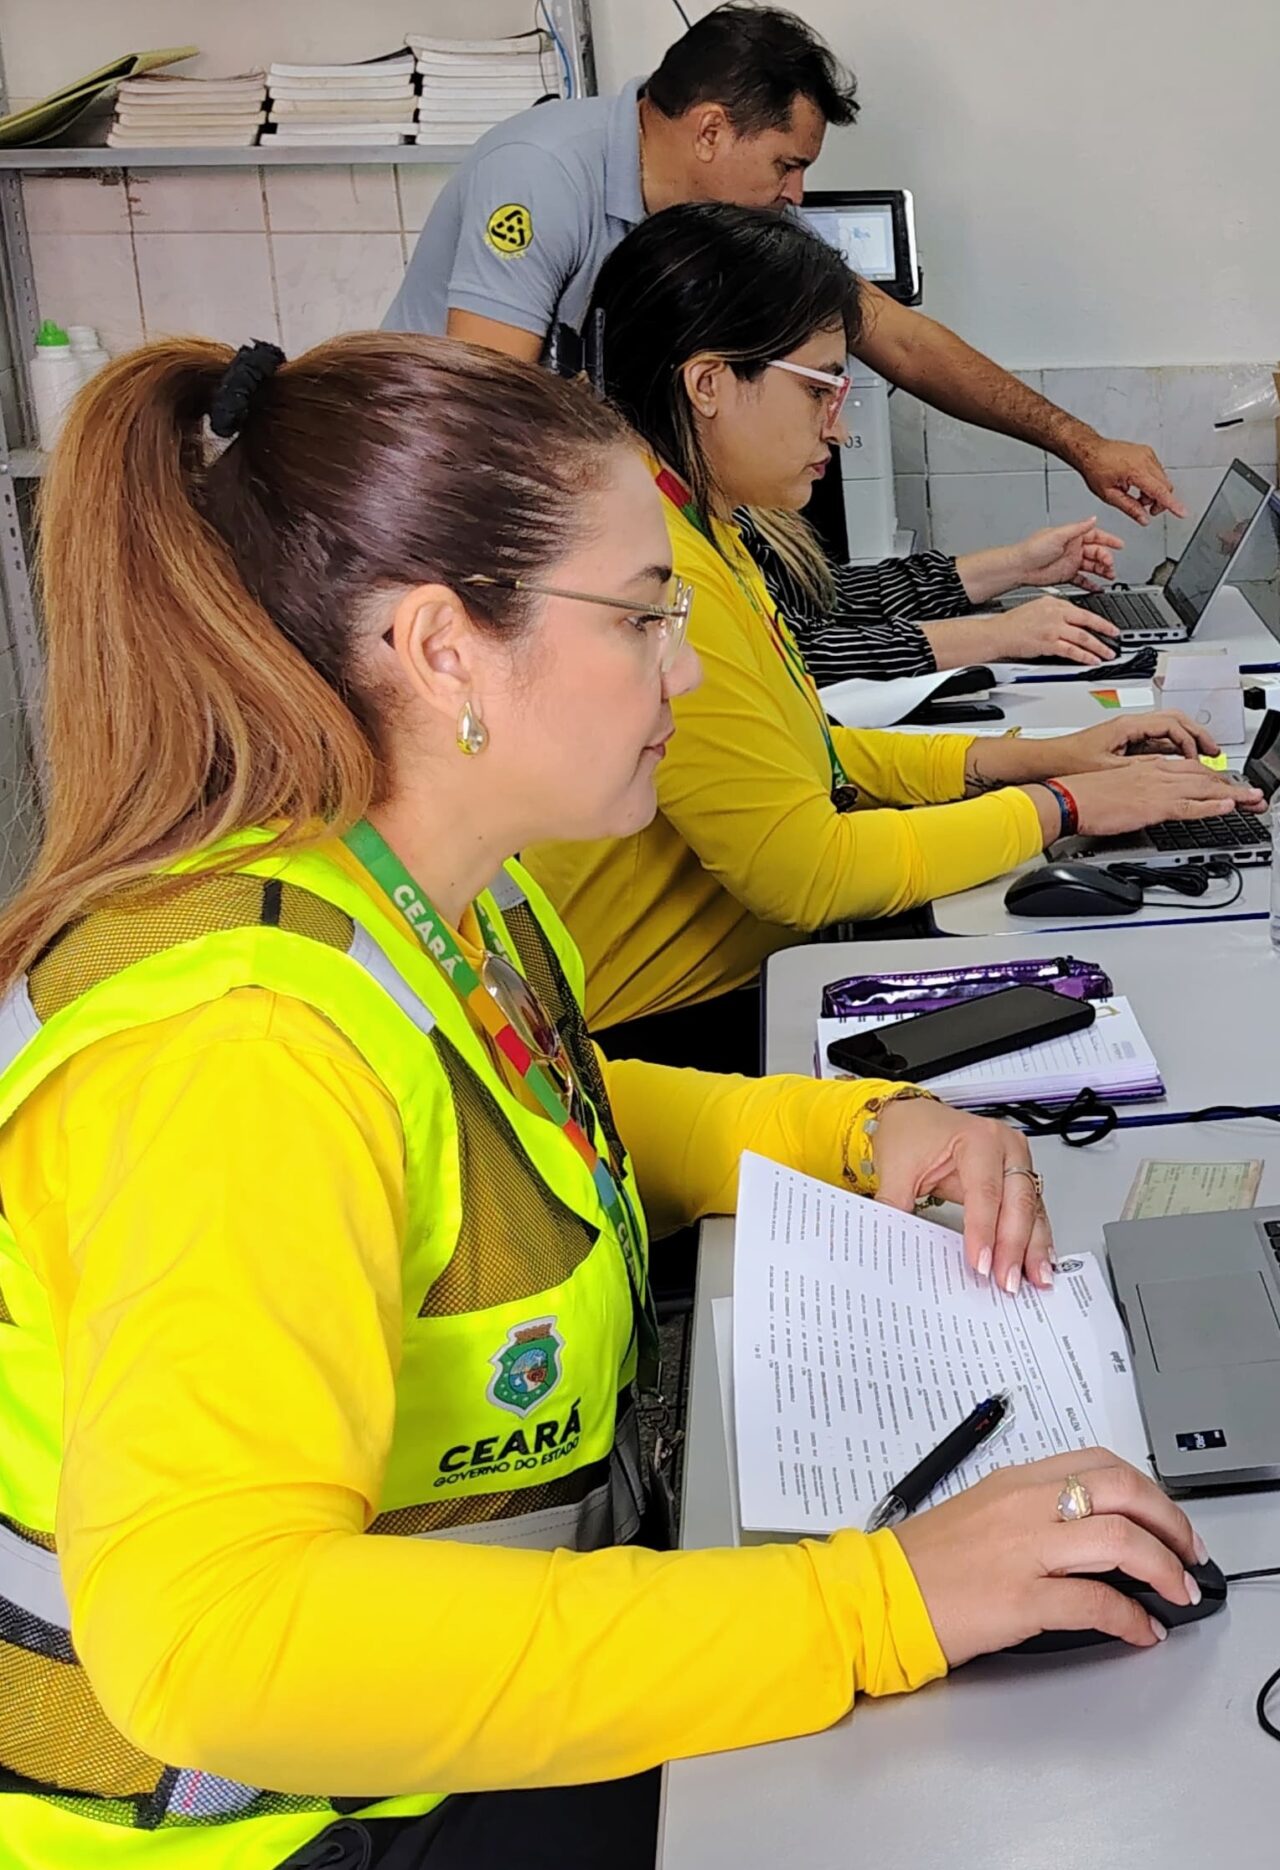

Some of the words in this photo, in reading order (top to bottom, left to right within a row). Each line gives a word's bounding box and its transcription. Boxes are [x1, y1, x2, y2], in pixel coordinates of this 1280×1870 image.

[393, 884, 463, 979] CEARÁ
[433, 1461, 510, 1487] GOVERNO
[514, 1457, 538, 1471] DO
[541, 1436, 580, 1466] ESTADO
[438, 1396, 582, 1473] CEARÁ
